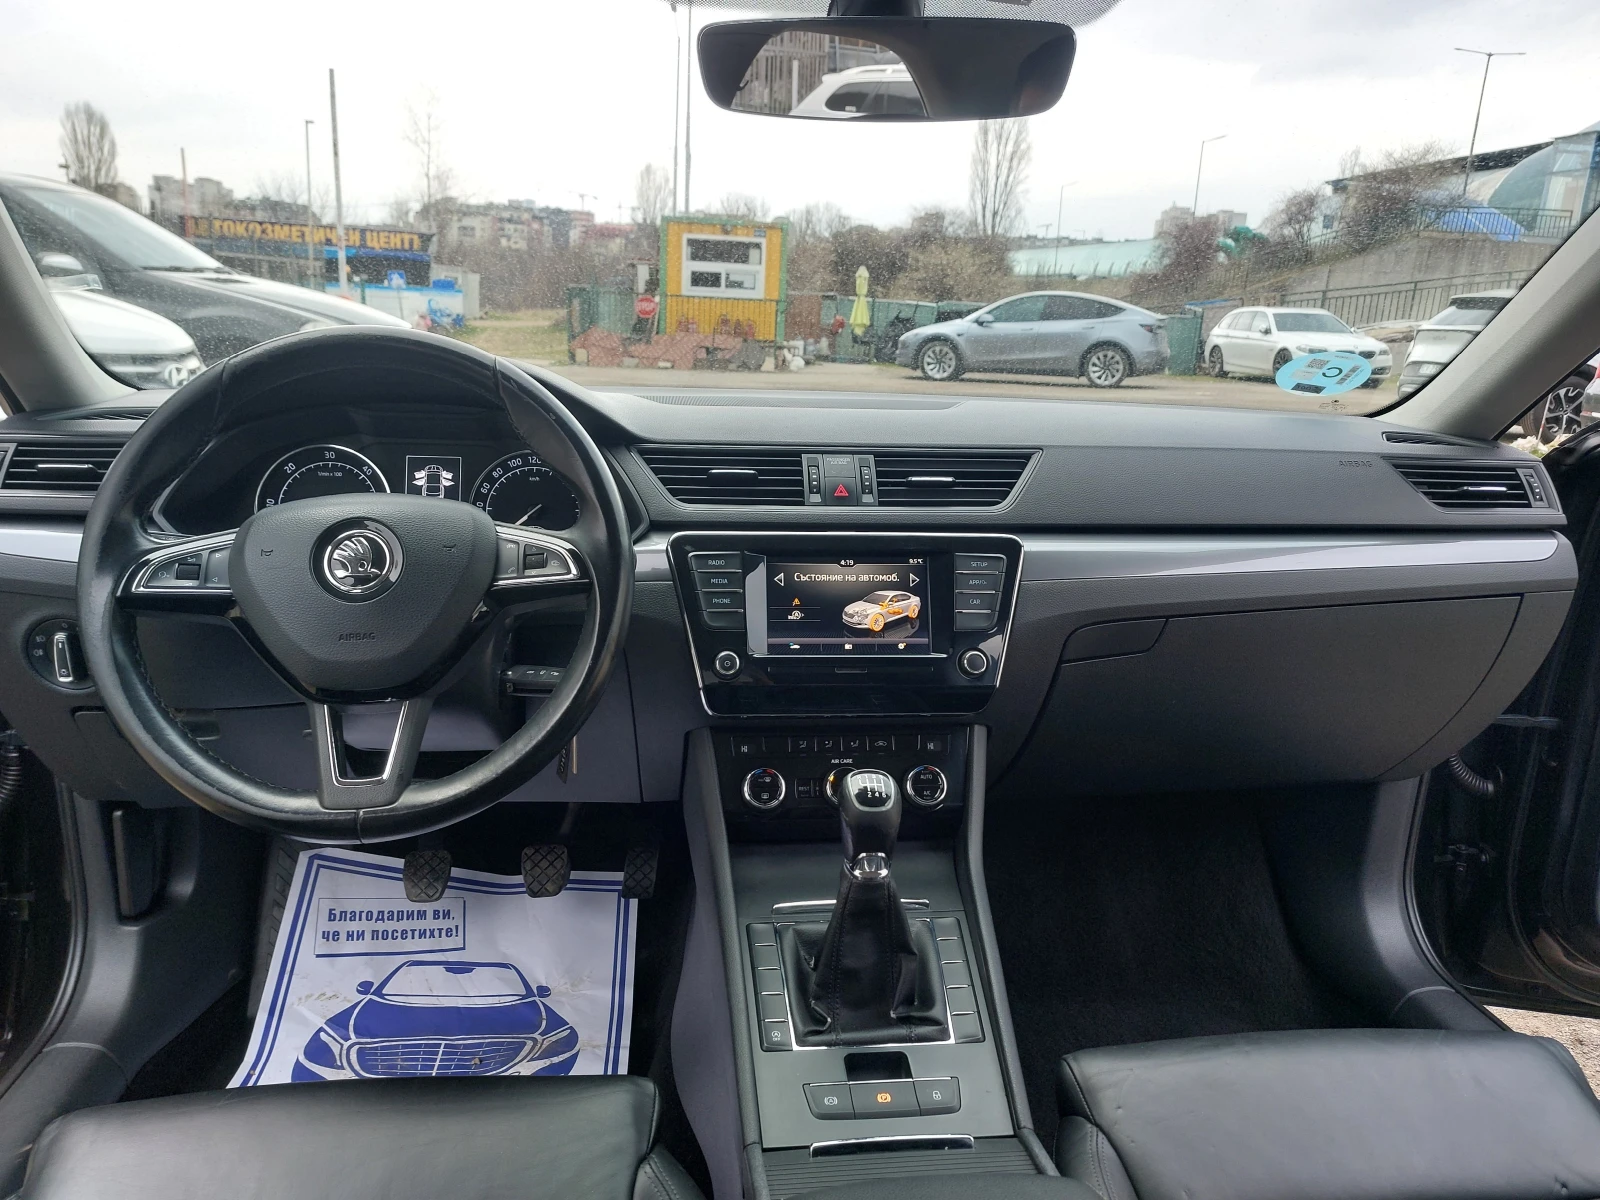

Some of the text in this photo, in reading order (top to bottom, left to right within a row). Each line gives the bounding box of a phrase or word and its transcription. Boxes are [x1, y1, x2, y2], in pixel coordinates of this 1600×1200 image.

[324, 451, 336, 459] 30
[283, 462, 296, 474] 20
[507, 458, 523, 468] 100
[1338, 460, 1373, 468] AIRBAG
[362, 465, 373, 476] 40
[492, 467, 503, 478] 80
[480, 482, 490, 494] 60
[794, 572, 900, 582] Състояние на автомоб.
[338, 631, 376, 642] AIRBAG
[327, 908, 427, 923] Благодарим
[321, 925, 459, 942] че ни посетихте!
